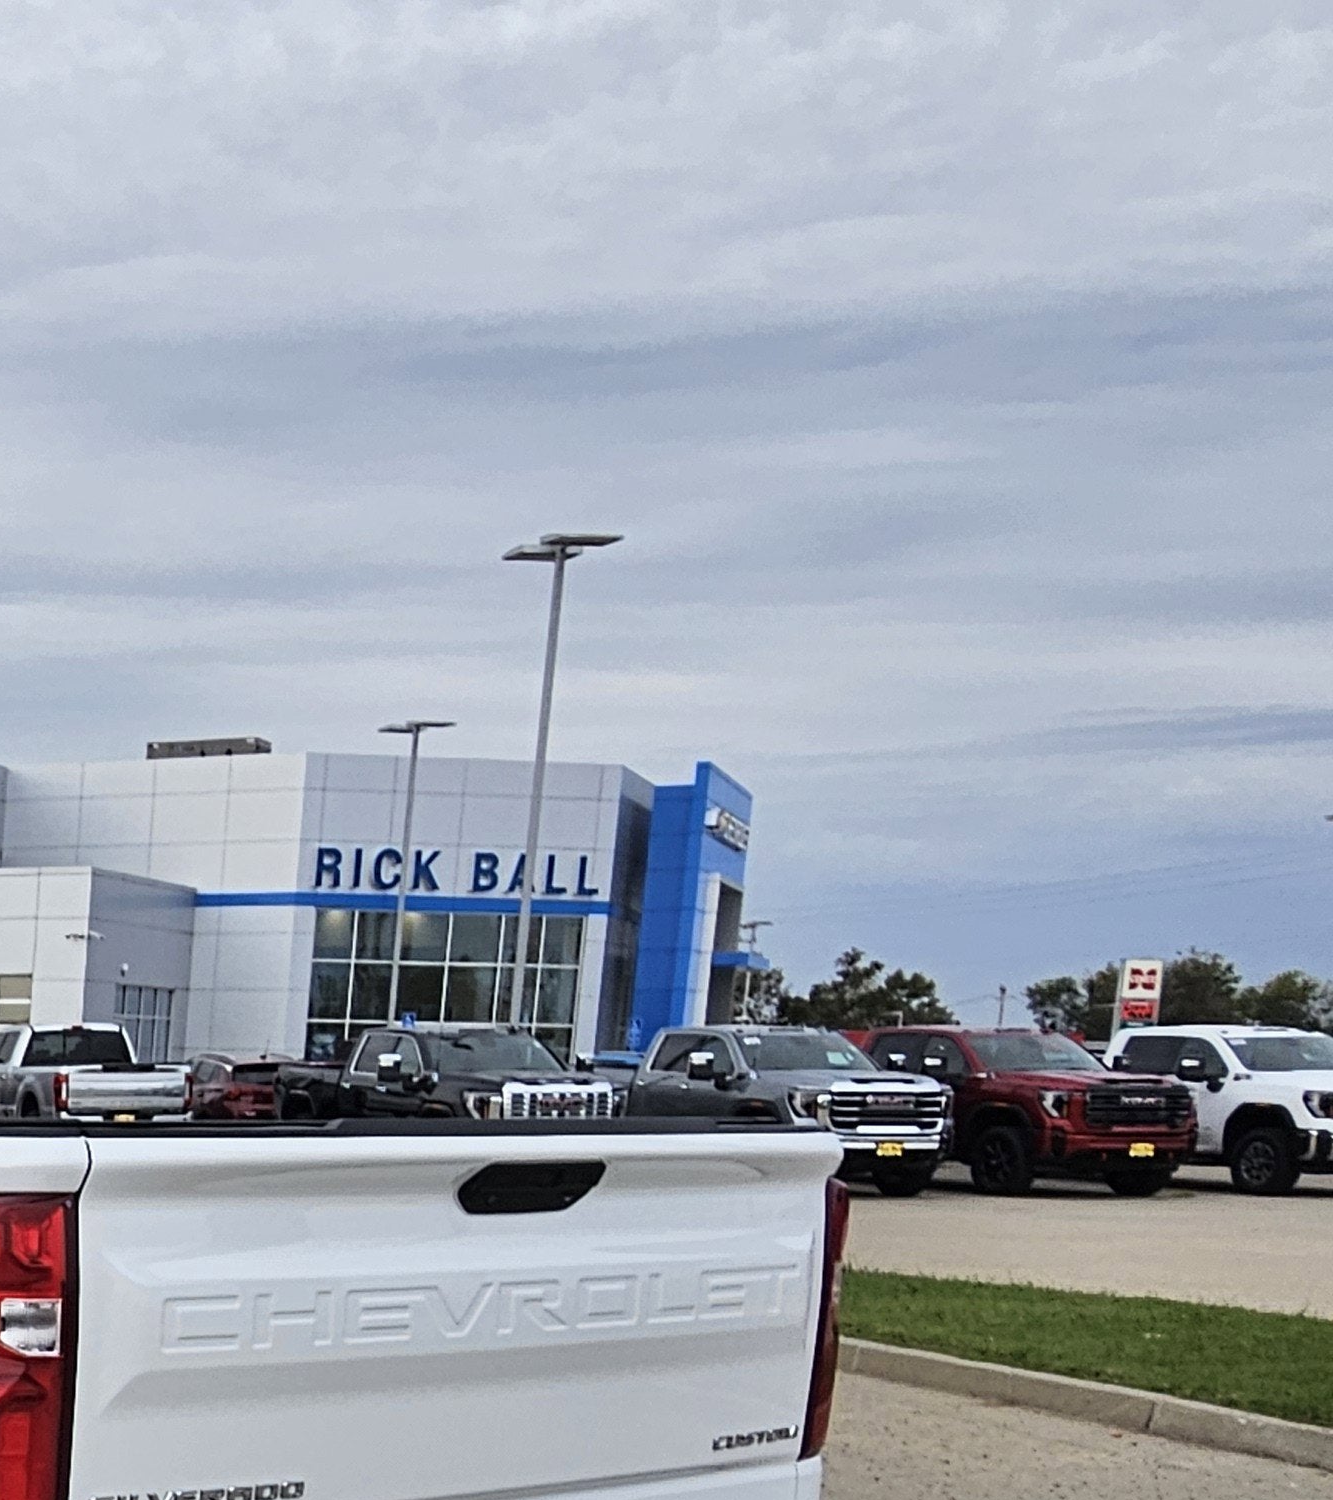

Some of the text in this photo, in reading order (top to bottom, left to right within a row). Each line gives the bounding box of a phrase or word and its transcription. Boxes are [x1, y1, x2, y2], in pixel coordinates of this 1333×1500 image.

[314, 847, 599, 896] RICK BALL
[161, 1264, 801, 1355] CHEVROLET
